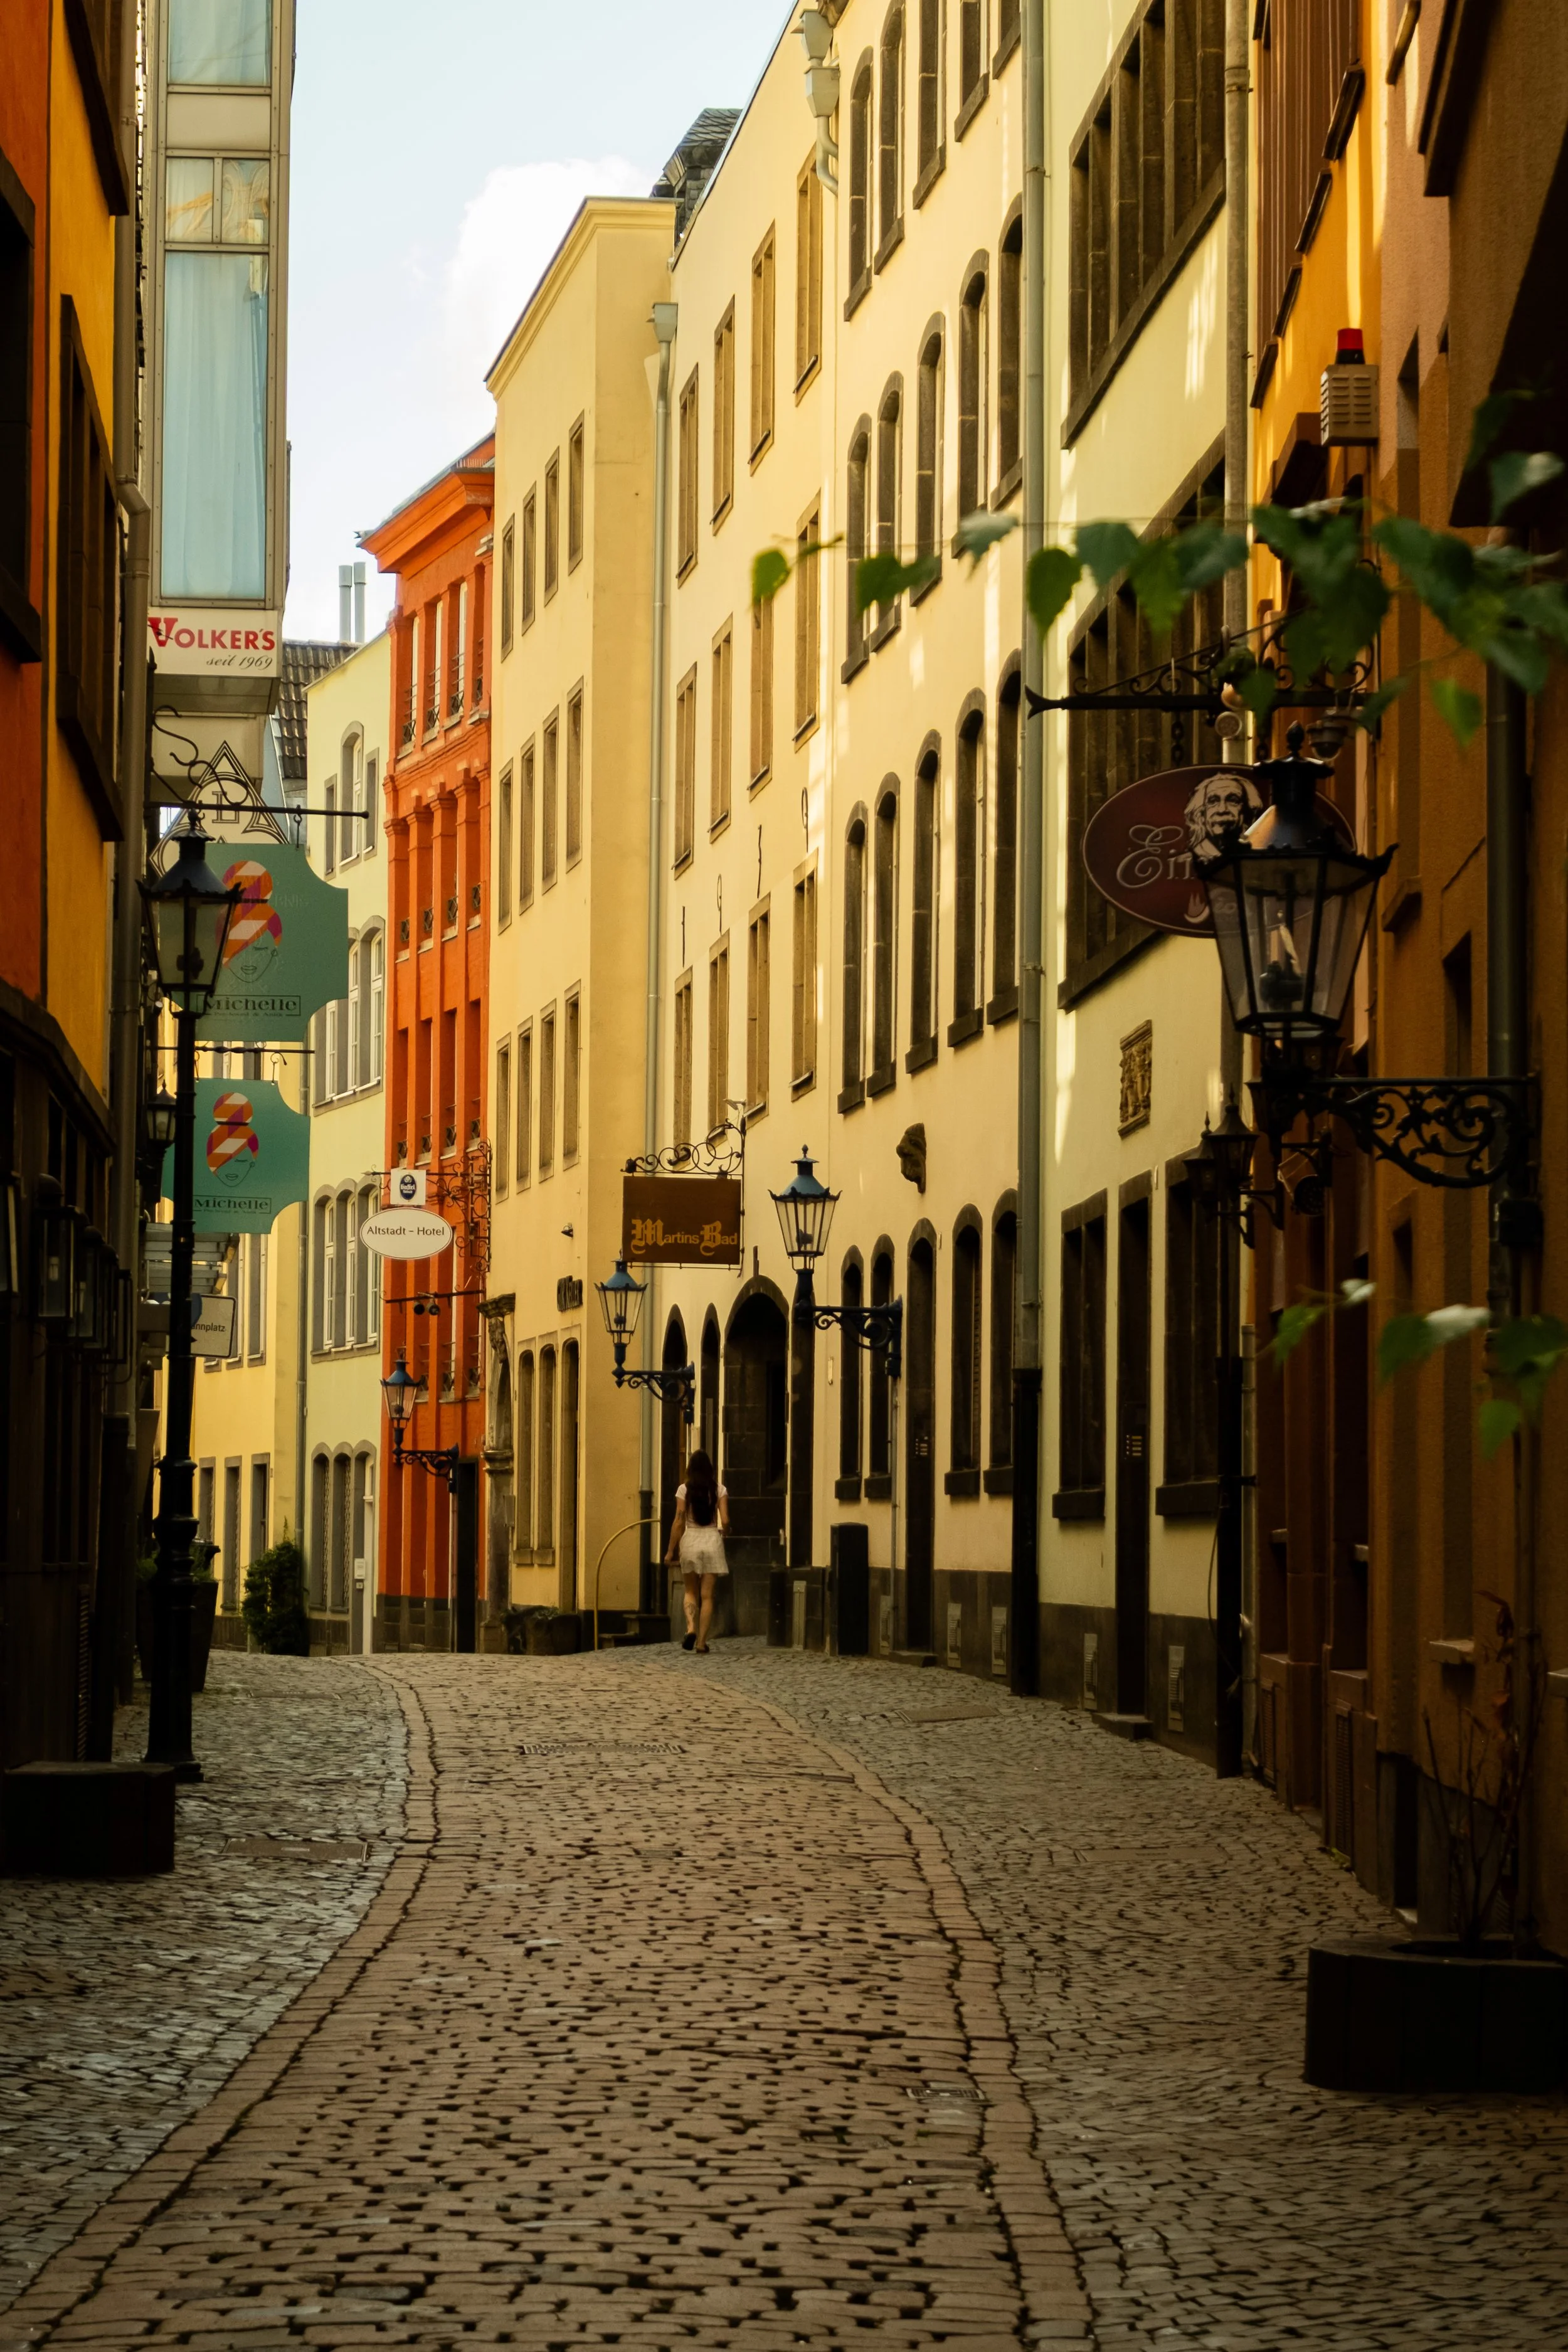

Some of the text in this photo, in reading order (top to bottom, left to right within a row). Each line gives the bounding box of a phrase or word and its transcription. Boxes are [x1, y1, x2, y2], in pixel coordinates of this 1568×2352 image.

[148, 617, 275, 651] VOLKER'S
[206, 655, 273, 670] seit 1969
[194, 1198, 268, 1210] Michelle
[366, 1226, 406, 1236] Altstadt
[417, 1227, 445, 1236] Hotel
[631, 1219, 738, 1256] Martins Bad
